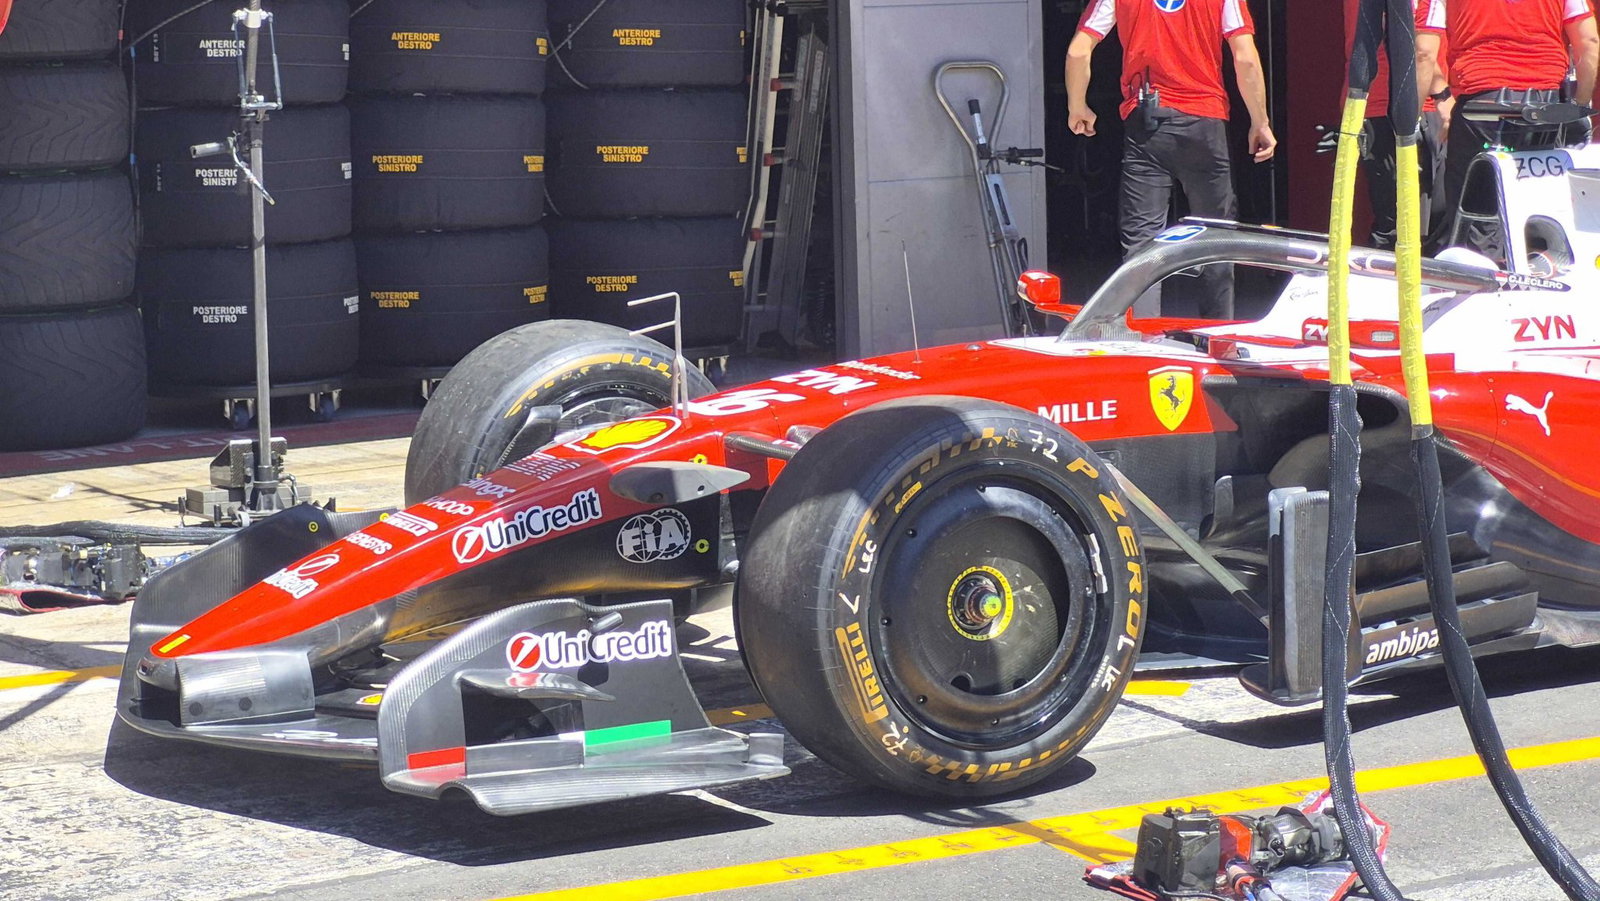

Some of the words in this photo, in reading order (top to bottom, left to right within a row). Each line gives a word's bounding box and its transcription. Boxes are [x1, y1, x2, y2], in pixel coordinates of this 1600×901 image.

[391, 32, 441, 42] ANTERIORE
[611, 29, 661, 38] ANTERIORE
[199, 39, 245, 49] ANTERIOR
[397, 41, 432, 50] DESTRO
[619, 37, 653, 46] DESTRO
[596, 146, 649, 155] POSTERIORE
[372, 155, 423, 164] POSTERIORE
[602, 154, 642, 163] SINISTRO
[378, 163, 417, 172] SINISTRO
[195, 168, 238, 178] POSTERIO
[203, 177, 238, 186] SINISTR
[1286, 242, 1397, 277] DC
[586, 275, 638, 285] POSTERIORE
[595, 284, 628, 292] DESTRO
[370, 291, 420, 300] POSTERIORE
[378, 300, 410, 308] DESTRO
[193, 305, 248, 315] POSTERIORE
[202, 314, 238, 324] DESTRO
[1304, 323, 1329, 342] ZY
[1512, 315, 1576, 342] ZYN
[1037, 399, 1118, 424] MILLE
[1028, 429, 1059, 462] 72
[486, 489, 602, 551] UniCredit
[1097, 490, 1141, 640] ZERO
[544, 620, 673, 666] UniCredit
[1365, 626, 1440, 664] ambipa
[835, 621, 890, 724] PIRELLI
